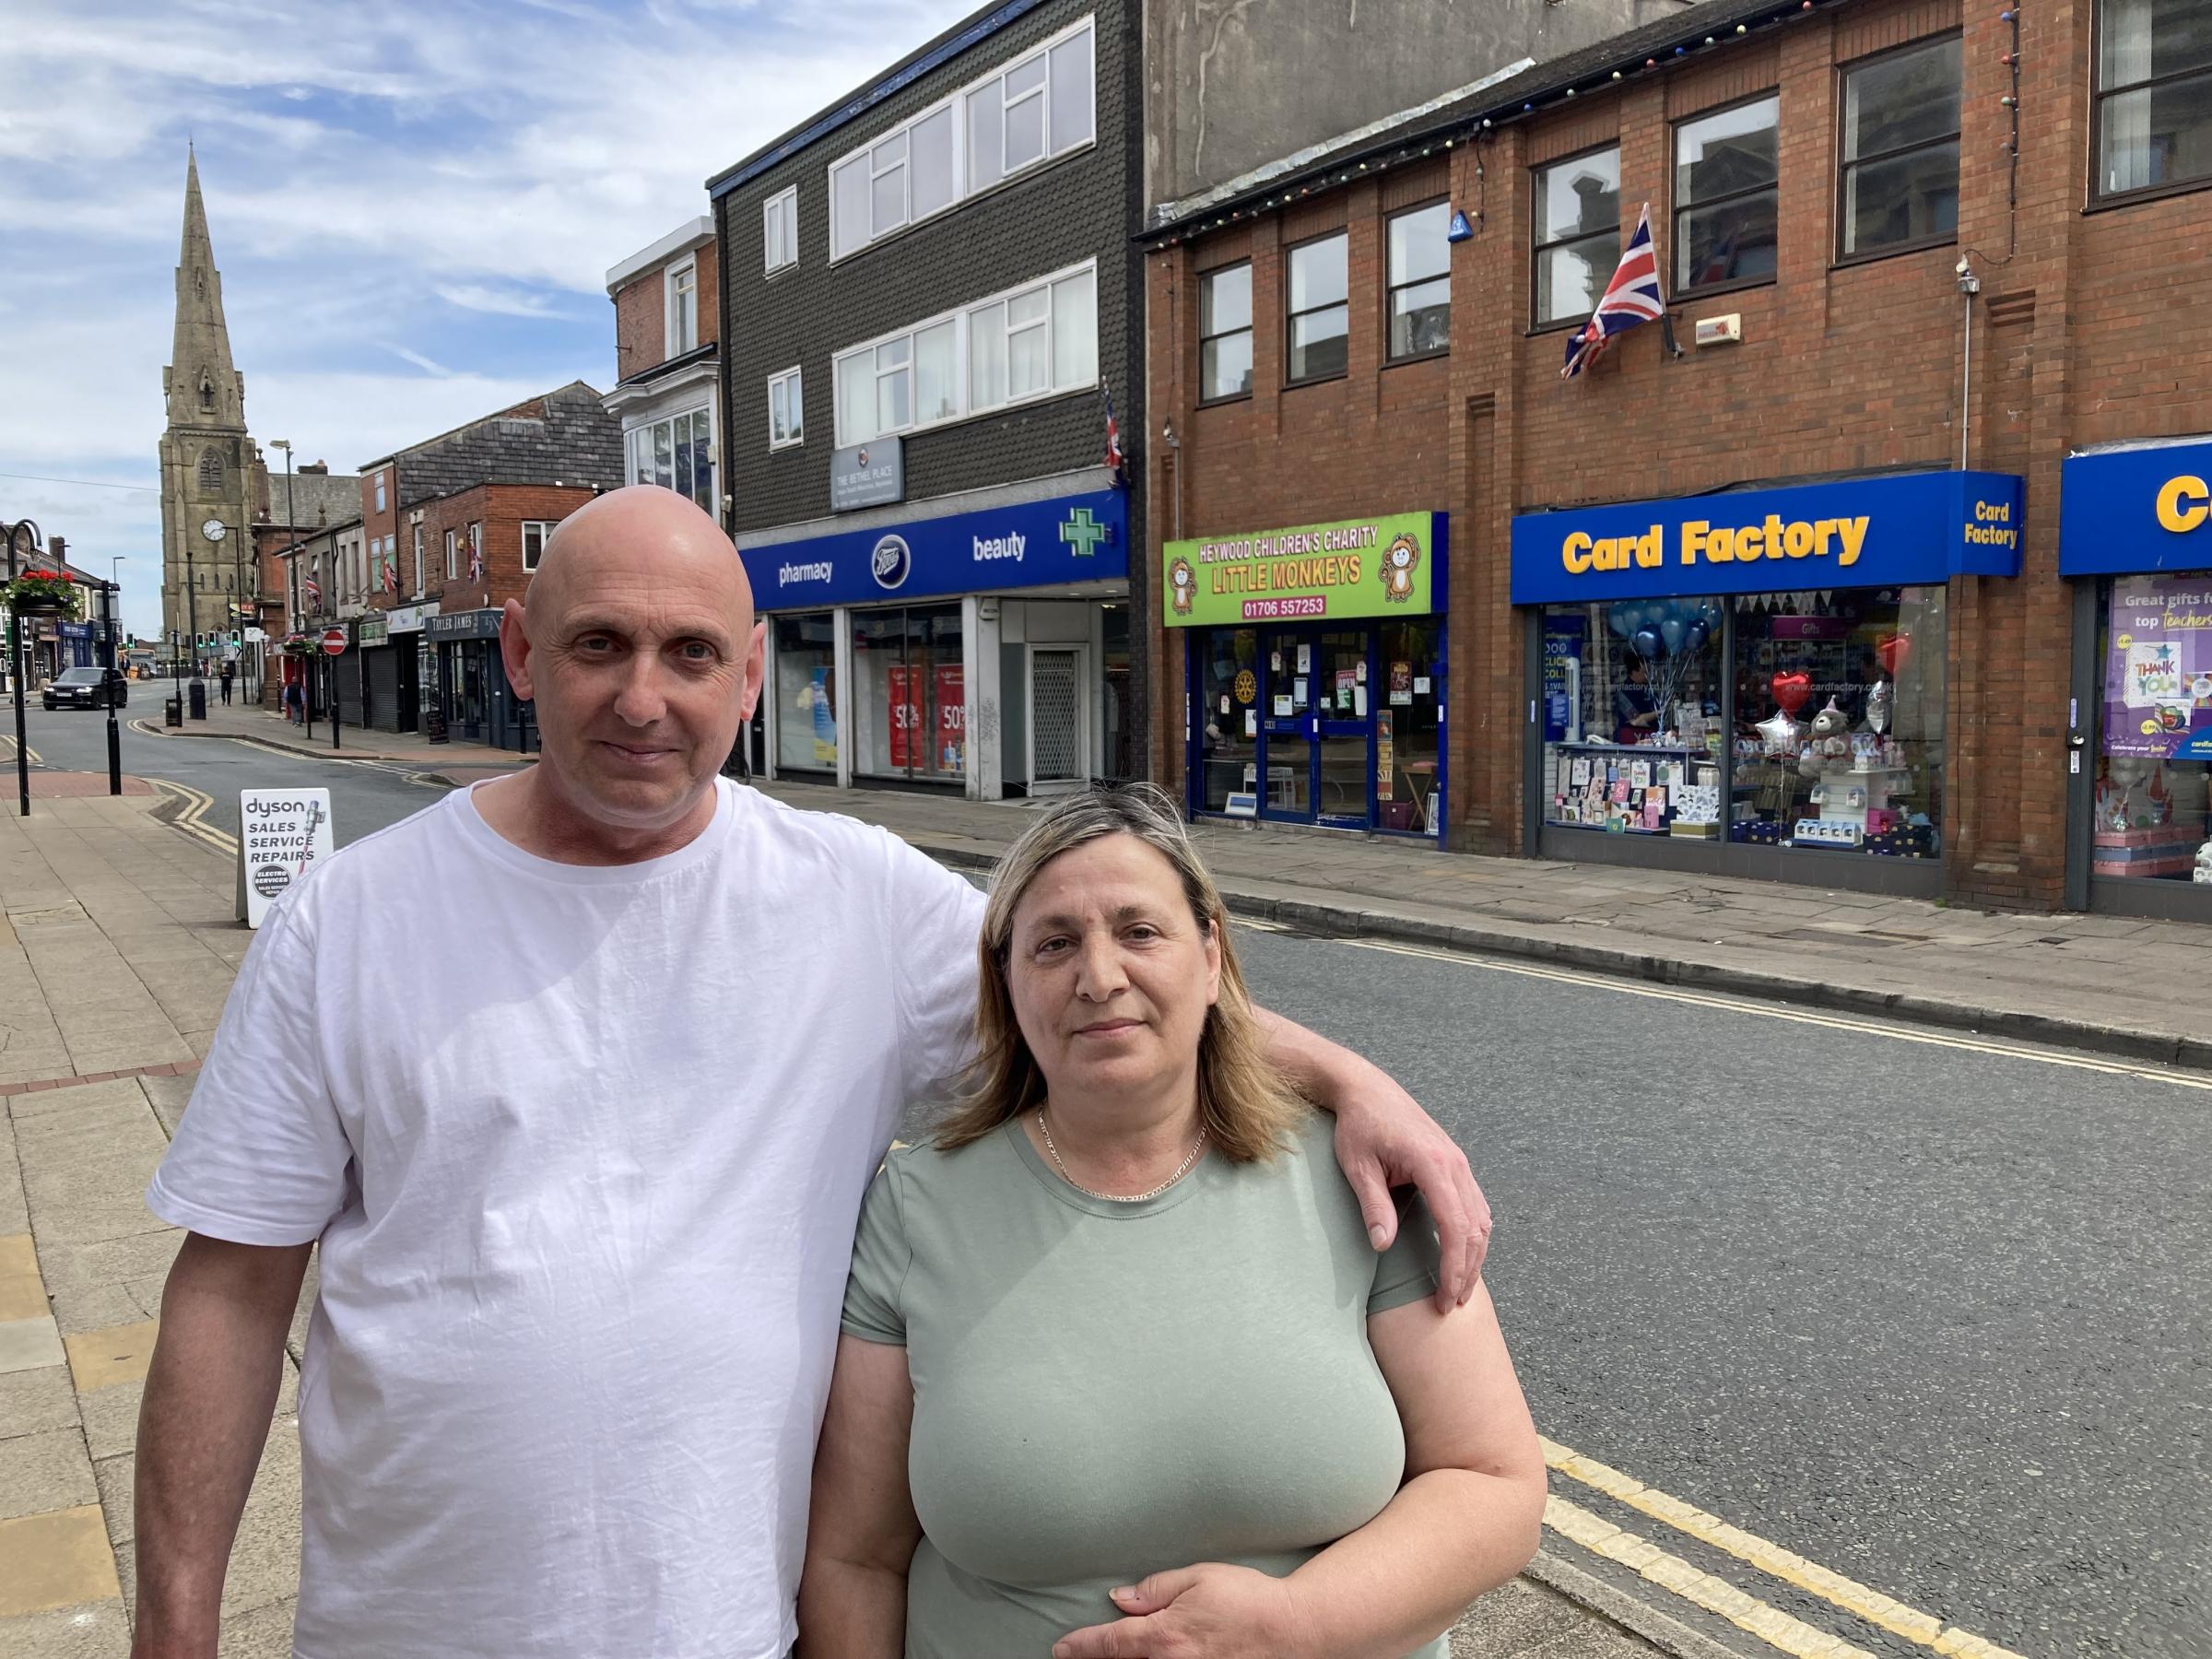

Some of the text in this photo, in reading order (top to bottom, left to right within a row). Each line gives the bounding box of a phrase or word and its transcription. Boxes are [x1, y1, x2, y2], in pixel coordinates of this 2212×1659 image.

[872, 465, 892, 479] PLACE
[1975, 500, 2009, 522] Card
[1199, 525, 1378, 564] HEYWOOD CHILDREN'S CHARITY
[1563, 513, 1870, 575] Card Factory
[1964, 523, 2018, 549] Factory
[973, 531, 1027, 561] beauty
[877, 547, 900, 576] Boots
[779, 561, 832, 588] pharmacy
[1212, 554, 1361, 594] LITTLE MONKEYS
[1244, 597, 1324, 617] 01706 557253
[2125, 594, 2165, 606] Great
[2168, 593, 2201, 608] gifts
[432, 618, 453, 631] TAYLER
[454, 615, 472, 632] JAMES
[1802, 623, 1820, 634] Gifts
[2135, 617, 2159, 630] top
[2135, 659, 2175, 677] THANK
[1337, 677, 1356, 689] OPEN
[245, 797, 305, 818] dyson
[249, 822, 296, 833] SALES
[250, 836, 314, 848] SERVICE
[250, 851, 315, 863] REPAIRS
